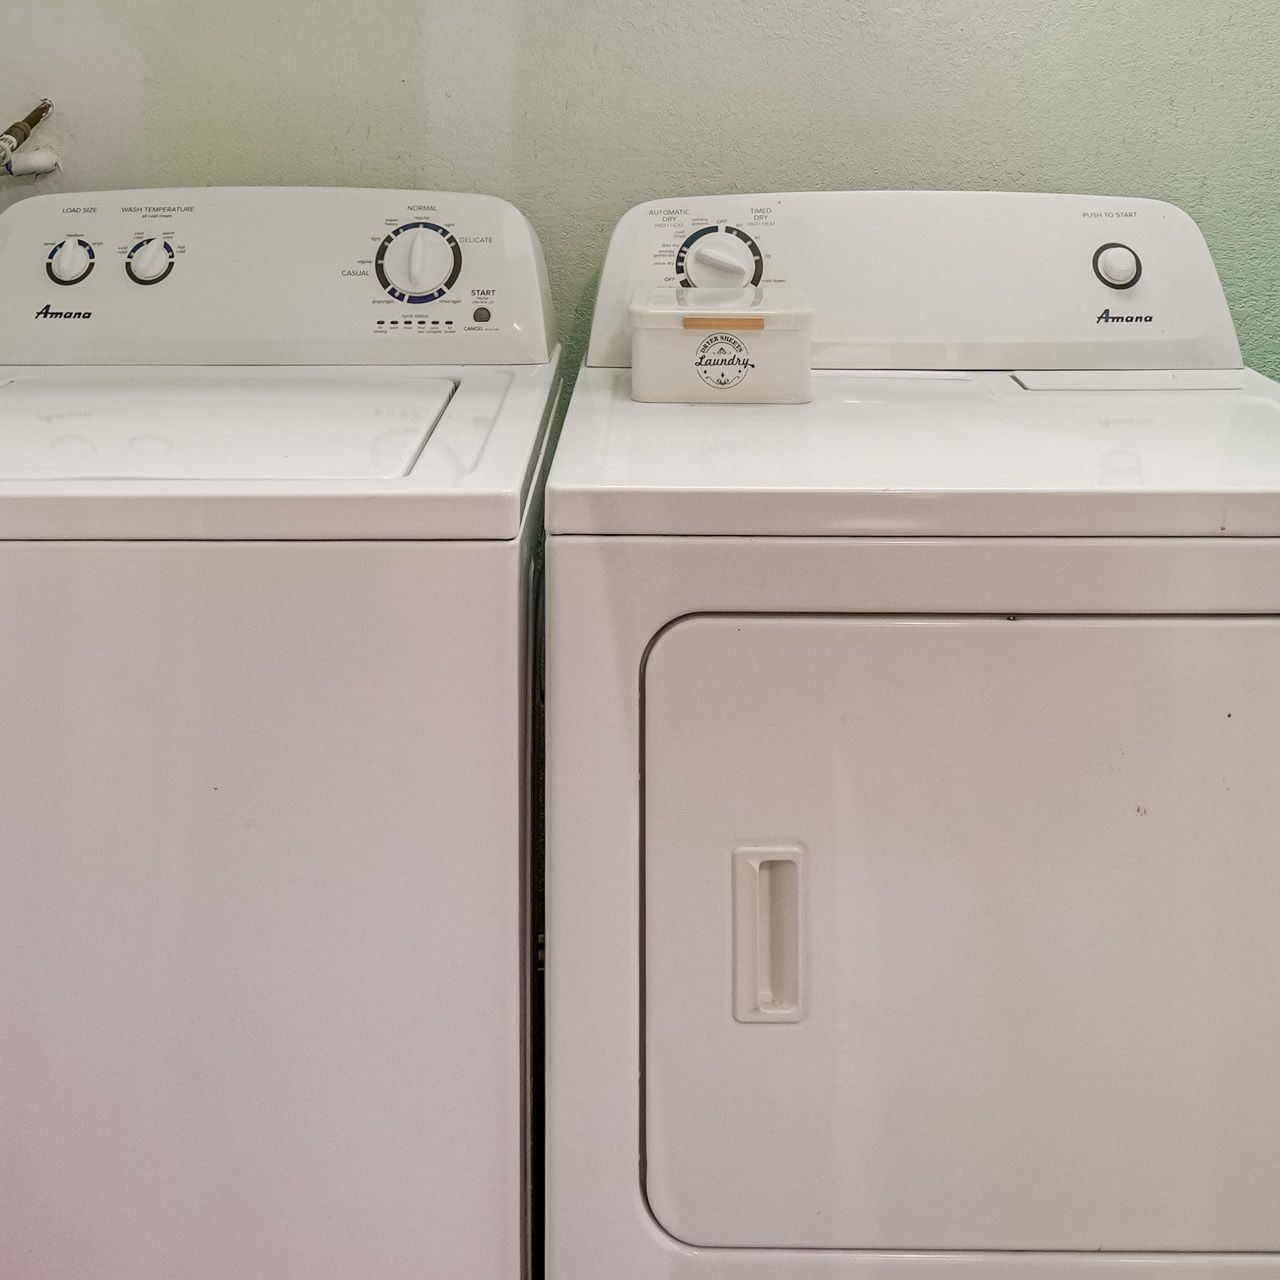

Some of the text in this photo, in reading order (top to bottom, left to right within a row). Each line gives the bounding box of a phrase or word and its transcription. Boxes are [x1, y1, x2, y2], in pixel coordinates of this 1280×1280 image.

[35, 304, 92, 319] Amana
[1096, 309, 1153, 324] Amana
[700, 335, 743, 354] DRYER SHEETS
[695, 354, 755, 369] Laundry
